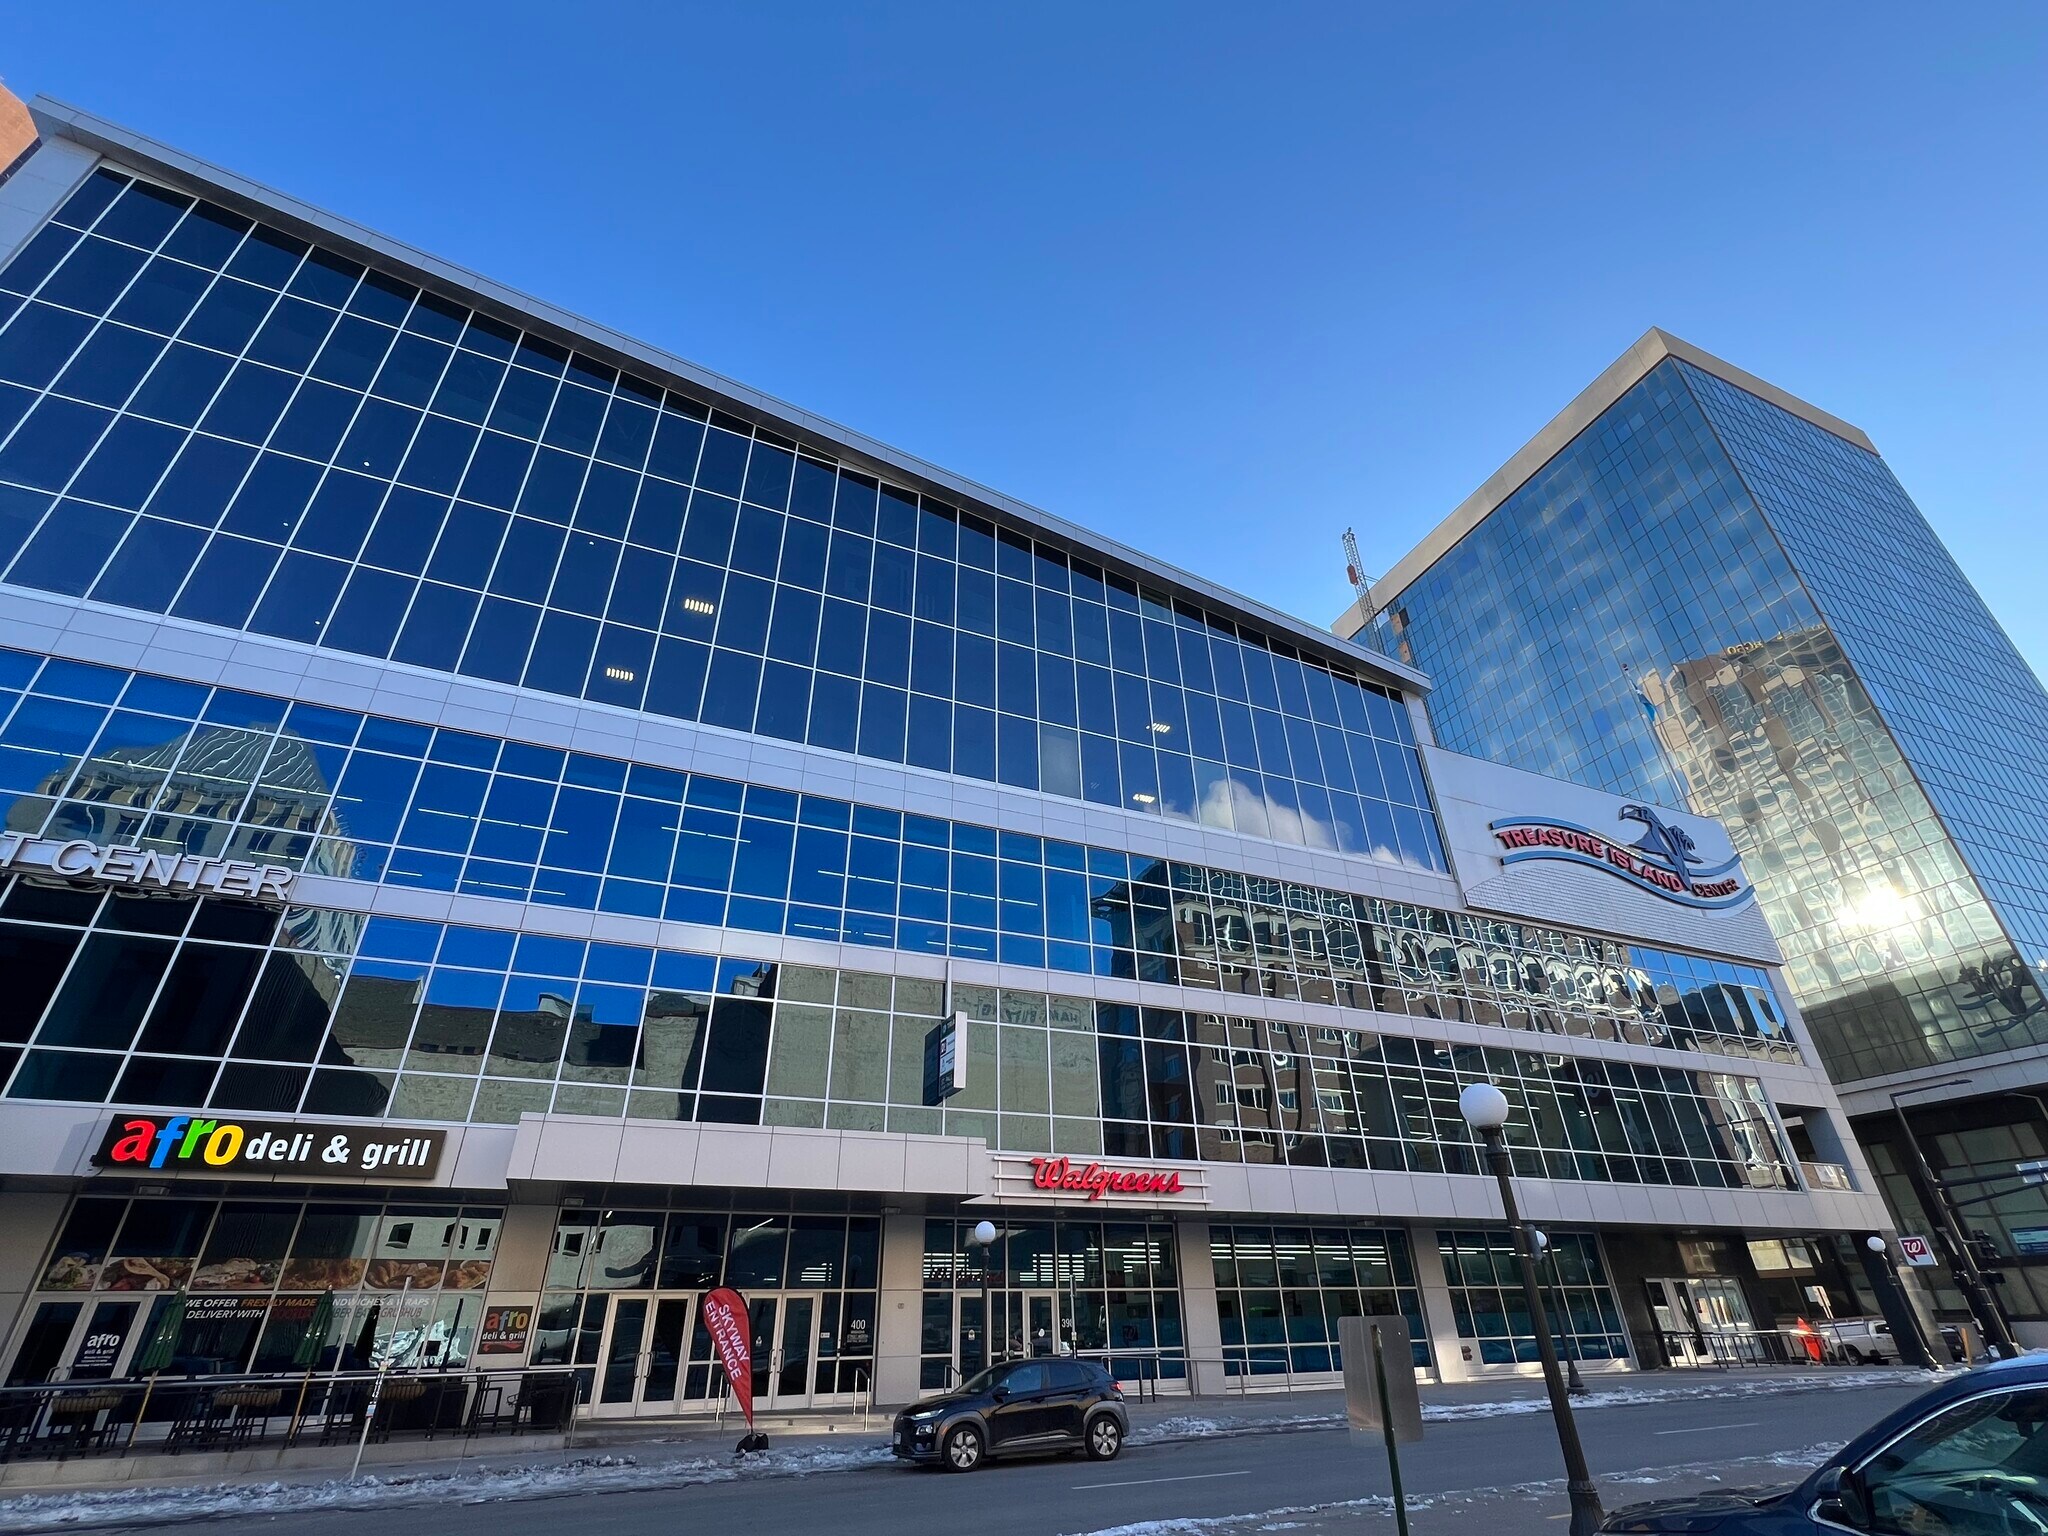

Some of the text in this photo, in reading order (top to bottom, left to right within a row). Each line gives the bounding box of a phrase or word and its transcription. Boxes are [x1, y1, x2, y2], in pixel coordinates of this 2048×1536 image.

[1, 830, 293, 901] T CENTER
[1496, 828, 1740, 898] TREASURE ISLAND CENTER
[111, 1115, 432, 1169] afro deli & grill
[1030, 1156, 1184, 1200] Walgreens
[185, 1299, 203, 1308] WE
[203, 1299, 239, 1308] OFFER
[286, 1299, 318, 1307] MADE
[186, 1310, 238, 1319] DELIVERY
[236, 1309, 265, 1318] WITH
[333, 1307, 352, 1318] BER
[482, 1331, 527, 1341] deli & grill
[486, 1310, 529, 1331] afro
[718, 1304, 750, 1361] SKYWAY
[850, 1319, 866, 1330] 400
[87, 1333, 121, 1348] afro
[705, 1301, 742, 1381] ENTRANCE
